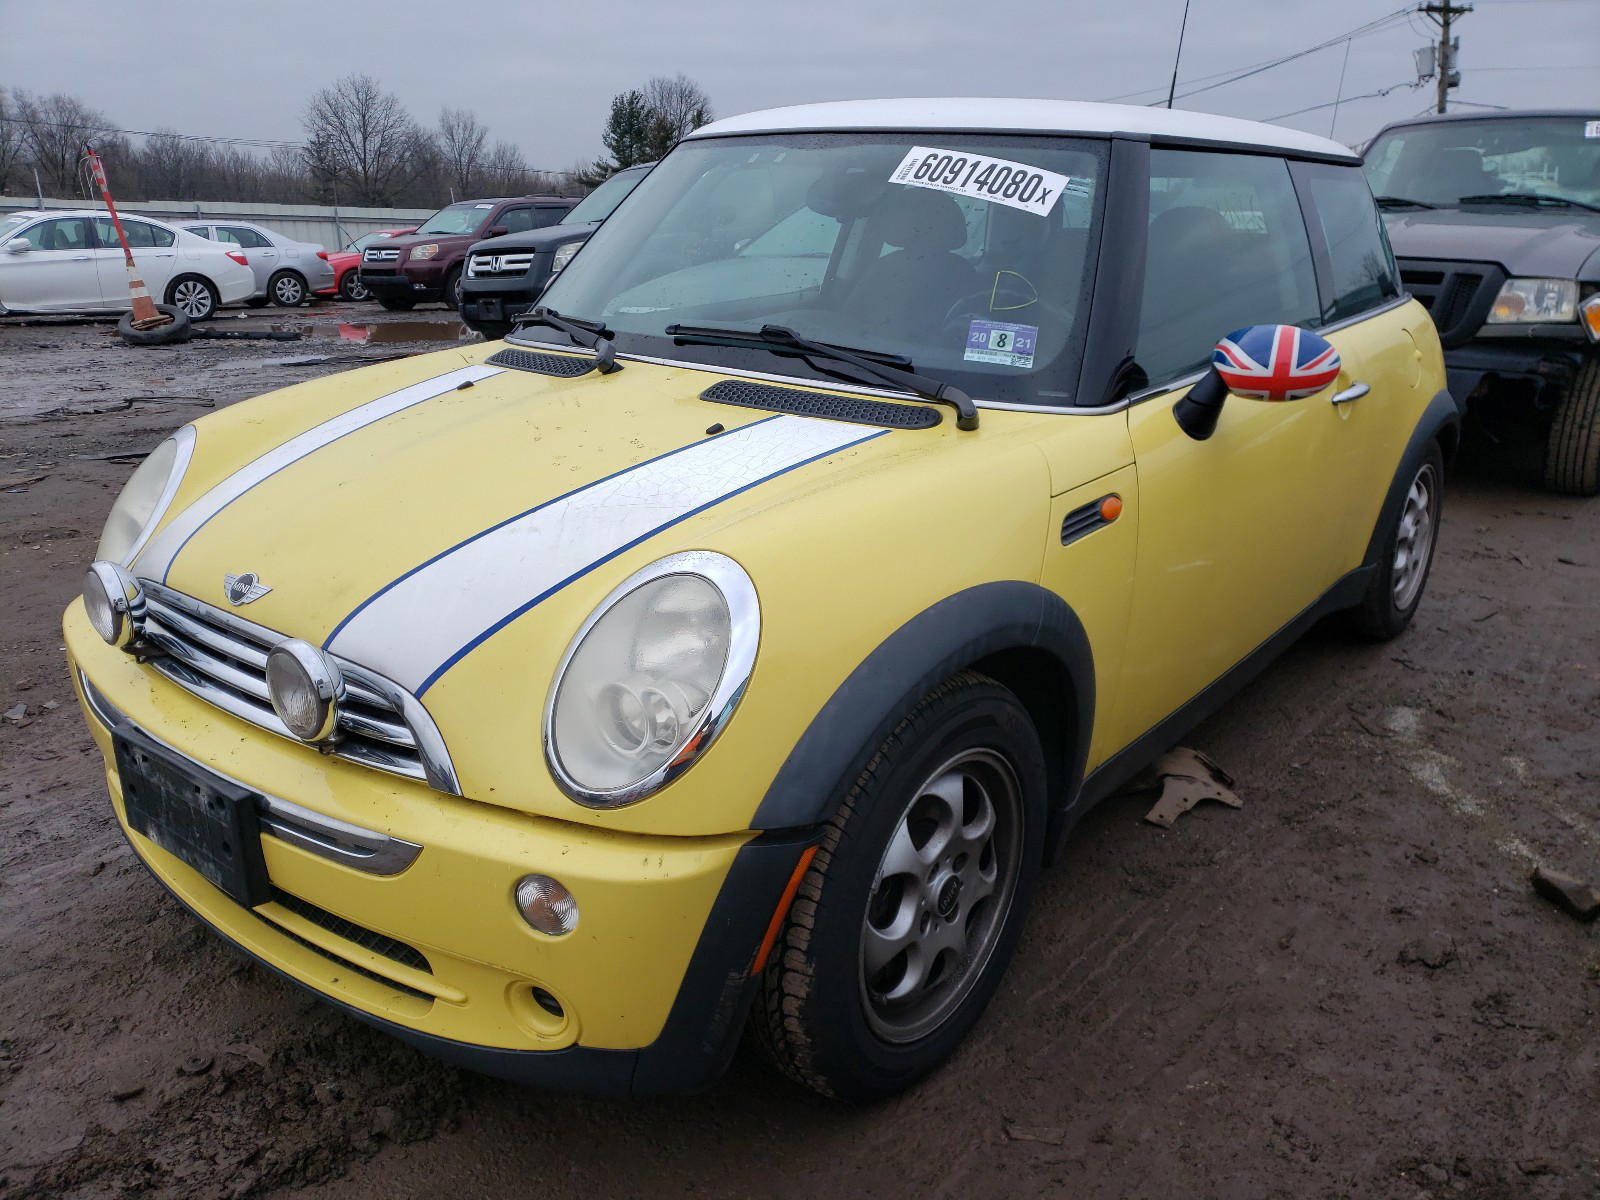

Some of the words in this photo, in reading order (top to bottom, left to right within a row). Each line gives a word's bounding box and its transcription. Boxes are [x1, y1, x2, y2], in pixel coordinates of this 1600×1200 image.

[971, 332, 987, 343] 20
[996, 333, 1008, 348] 8
[1015, 337, 1031, 349] 21
[232, 582, 252, 594] MINI
